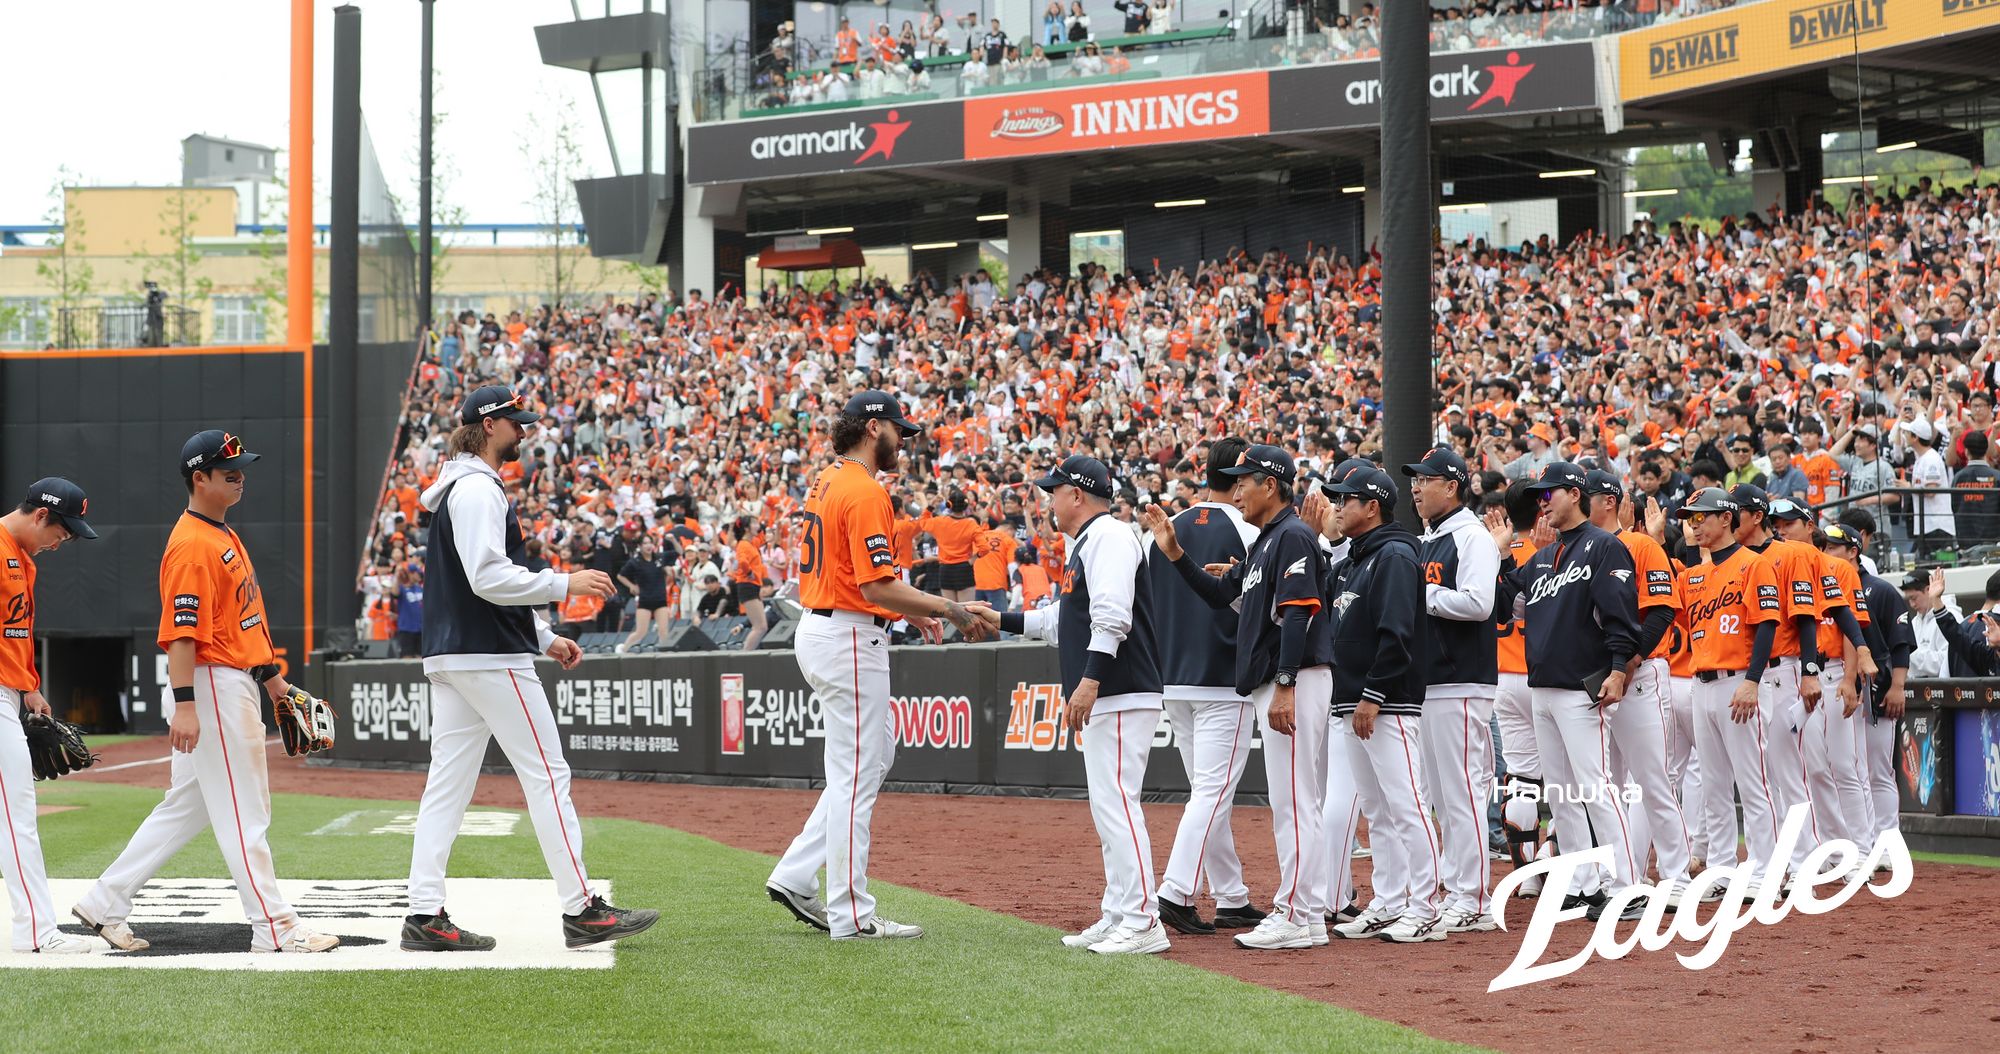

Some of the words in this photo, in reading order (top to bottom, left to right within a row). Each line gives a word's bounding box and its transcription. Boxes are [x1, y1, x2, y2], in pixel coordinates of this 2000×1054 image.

[1790, 0, 1887, 45] DEWALT
[1650, 27, 1739, 76] DEWALT
[1345, 64, 1480, 105] arark
[1071, 89, 1239, 137] INNINGS
[751, 122, 866, 160] aramark
[1526, 560, 1592, 606] Eagles
[1687, 586, 1744, 630] Eagles
[1719, 614, 1740, 635] 82
[350, 682, 433, 741] 한화손해
[556, 678, 693, 727] 한국폴리텍대학
